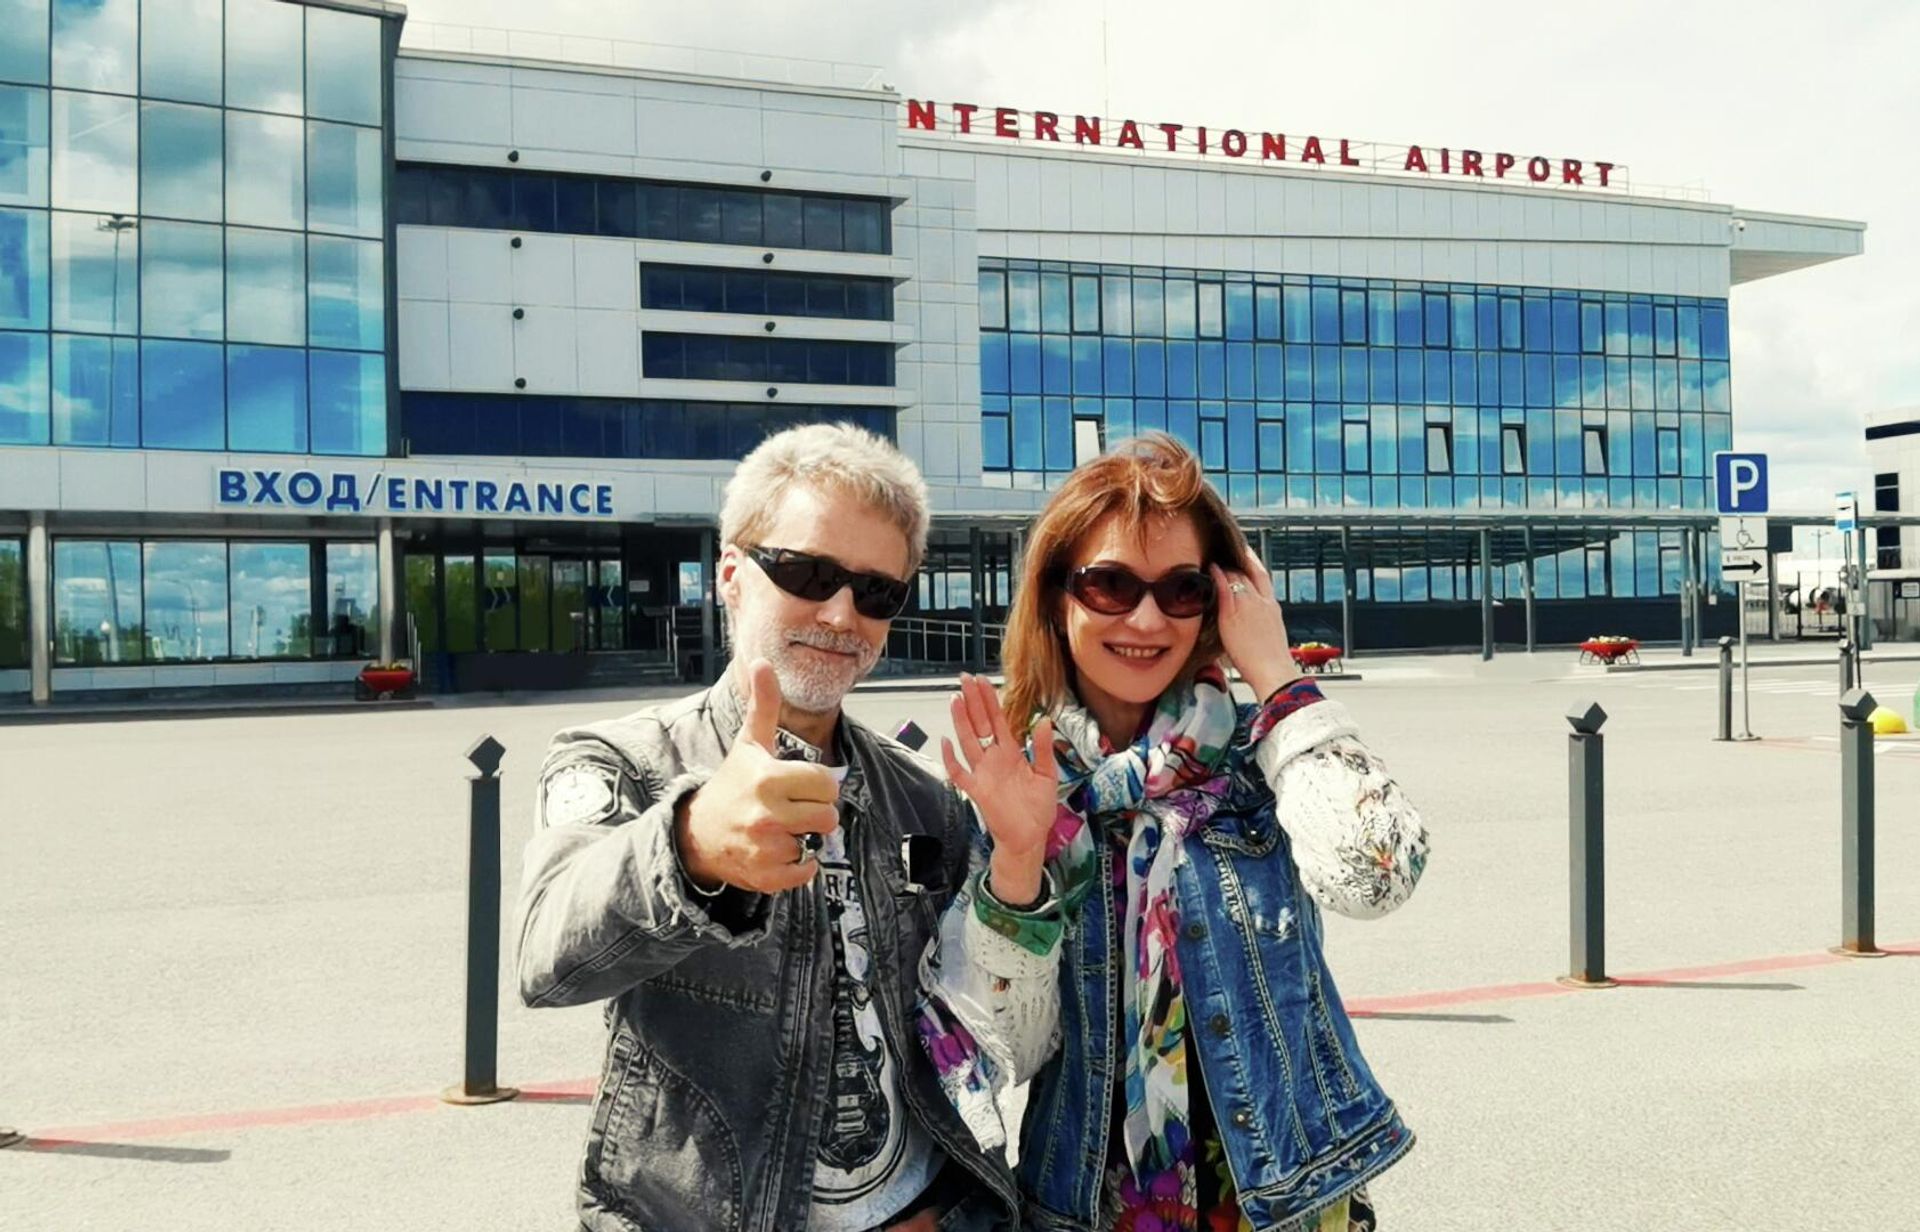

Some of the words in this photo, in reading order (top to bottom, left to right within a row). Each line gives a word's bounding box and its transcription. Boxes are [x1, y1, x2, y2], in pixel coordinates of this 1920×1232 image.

[907, 98, 1360, 166] NTERNATIONAL
[1404, 145, 1614, 187] AIRPORT
[218, 470, 613, 515] ВХОД/ENTRANCE
[1730, 459, 1759, 508] P
